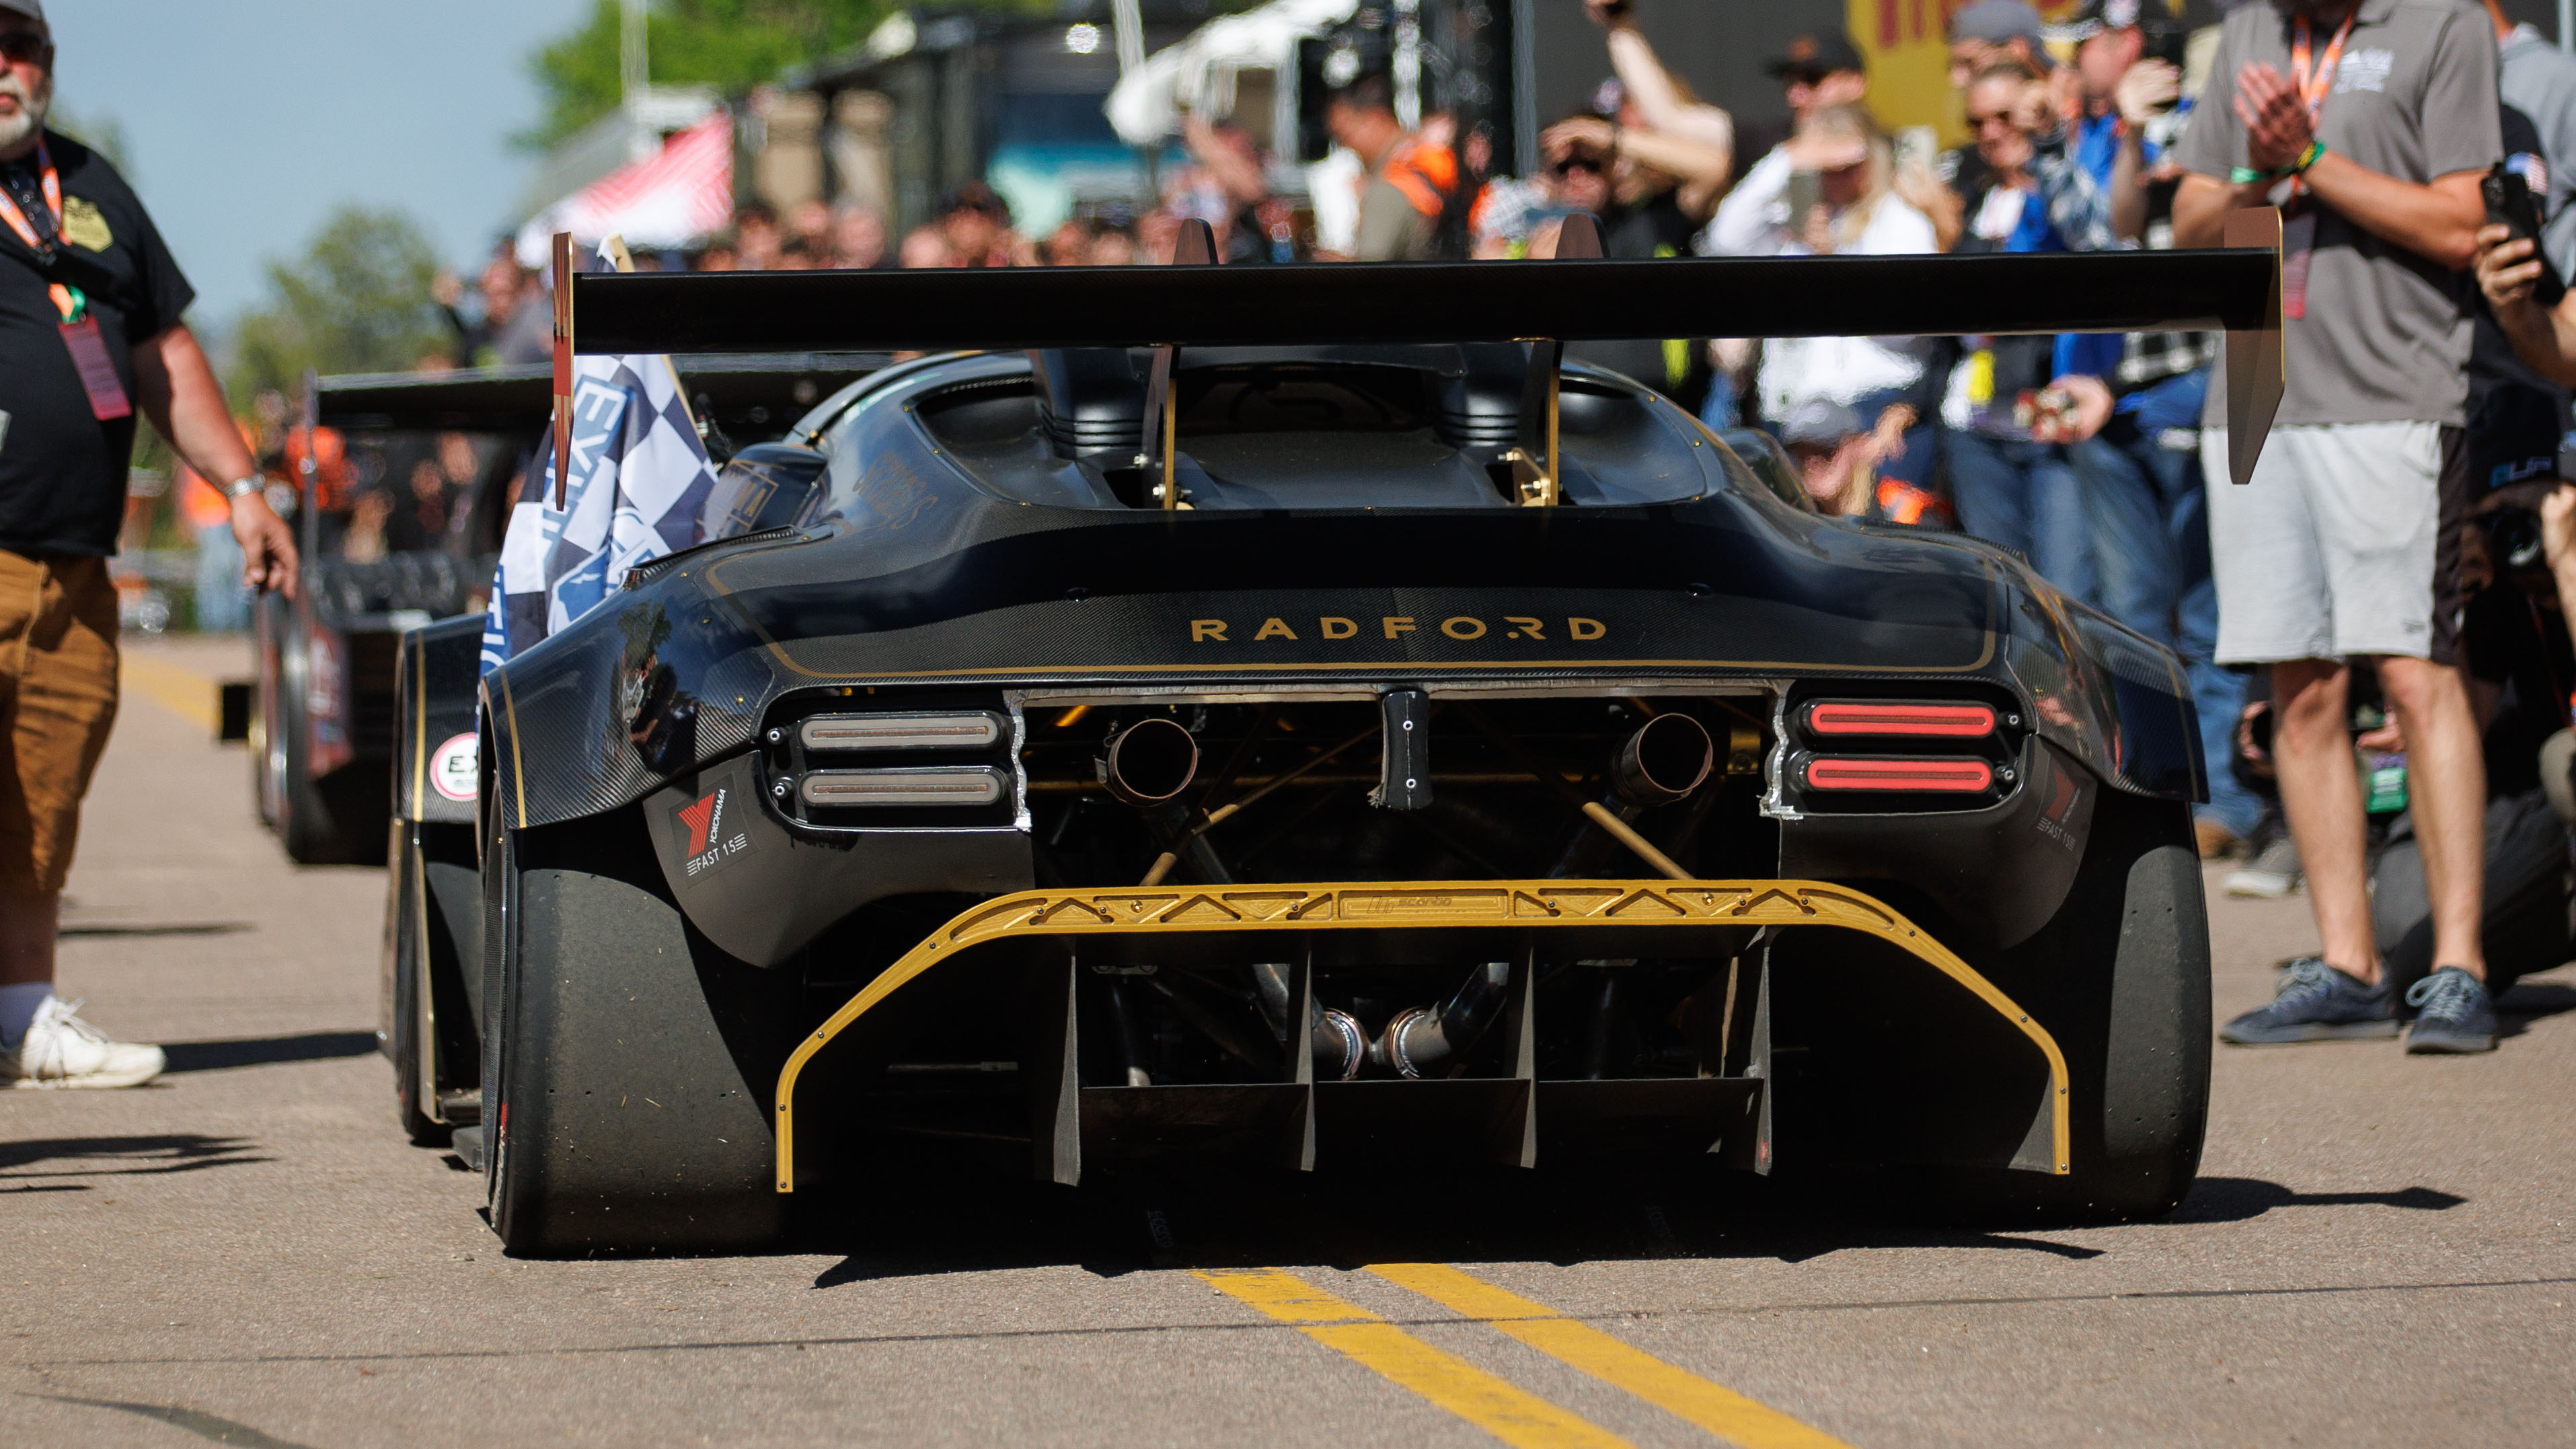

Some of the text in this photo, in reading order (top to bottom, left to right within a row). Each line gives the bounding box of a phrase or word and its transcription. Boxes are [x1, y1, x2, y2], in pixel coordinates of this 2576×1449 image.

[1191, 616, 1606, 641] RADFORD
[710, 788, 726, 844] YOKOHAMA
[2045, 821, 2062, 840] FAST
[696, 840, 736, 871] FAST 15
